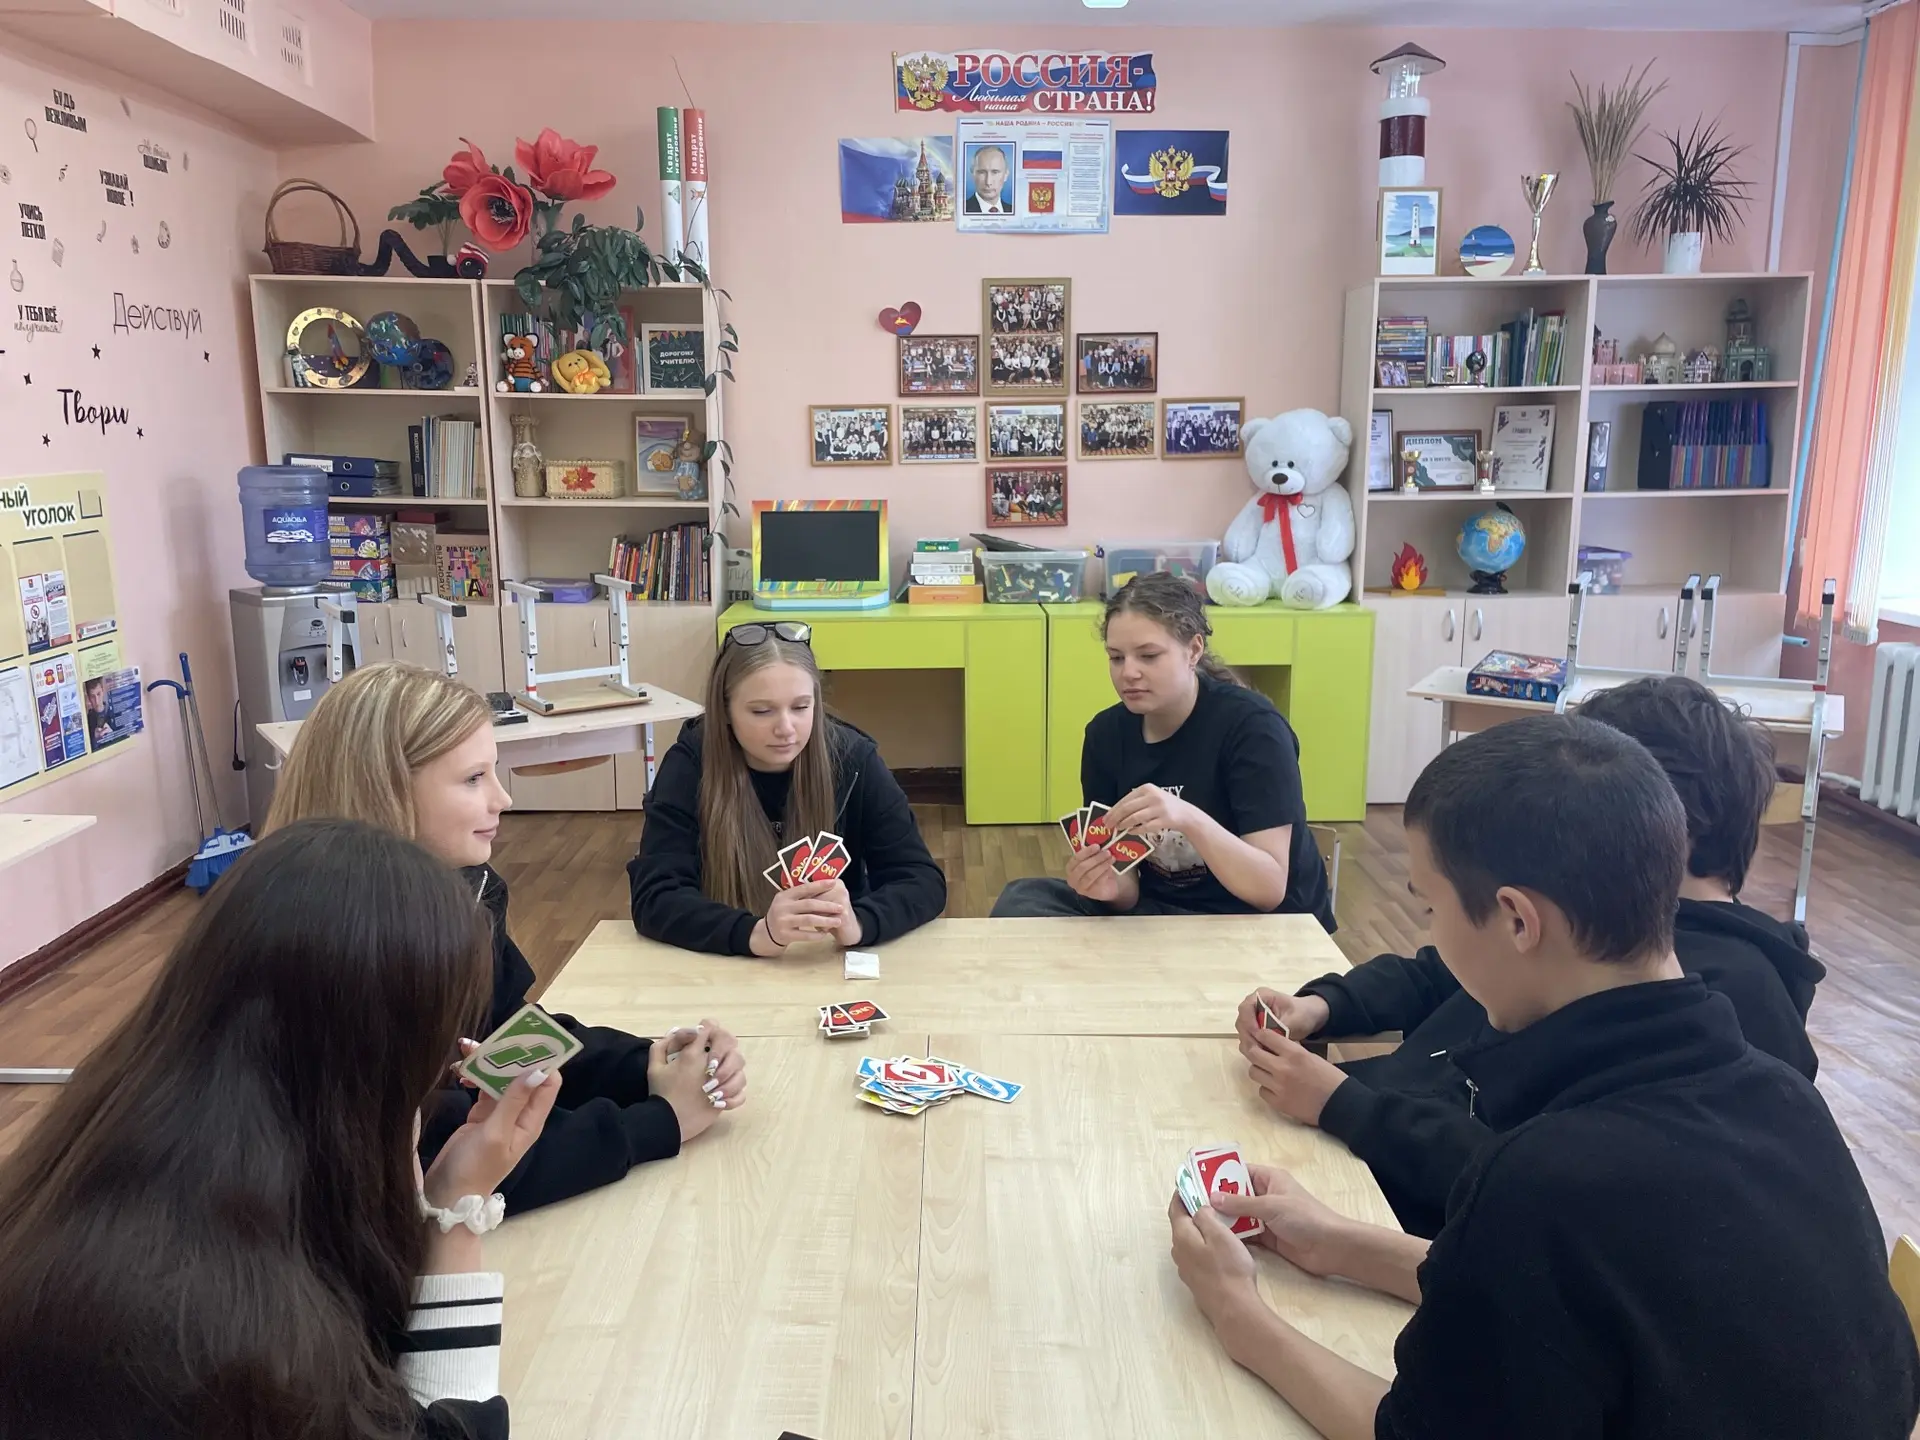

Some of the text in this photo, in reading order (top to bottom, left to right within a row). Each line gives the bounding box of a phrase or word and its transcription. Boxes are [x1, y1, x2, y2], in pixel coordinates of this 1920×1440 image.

[53, 89, 75, 112] БУДЬ
[952, 80, 1028, 103] Любимая
[1033, 91, 1152, 112] СТРАНА!
[984, 103, 1018, 111] наша
[666, 132, 674, 173] Квадрат
[690, 133, 698, 174] Квадрат
[25, 305, 44, 321] ТЕБЯ
[113, 292, 202, 339] Действуй
[57, 388, 130, 435] Твори
[22, 505, 75, 527] УГОЛОК
[1088, 825, 1111, 836] UNO
[1116, 842, 1138, 859] UNO
[820, 862, 837, 878] UNO
[1200, 1162, 1207, 1172] 4
